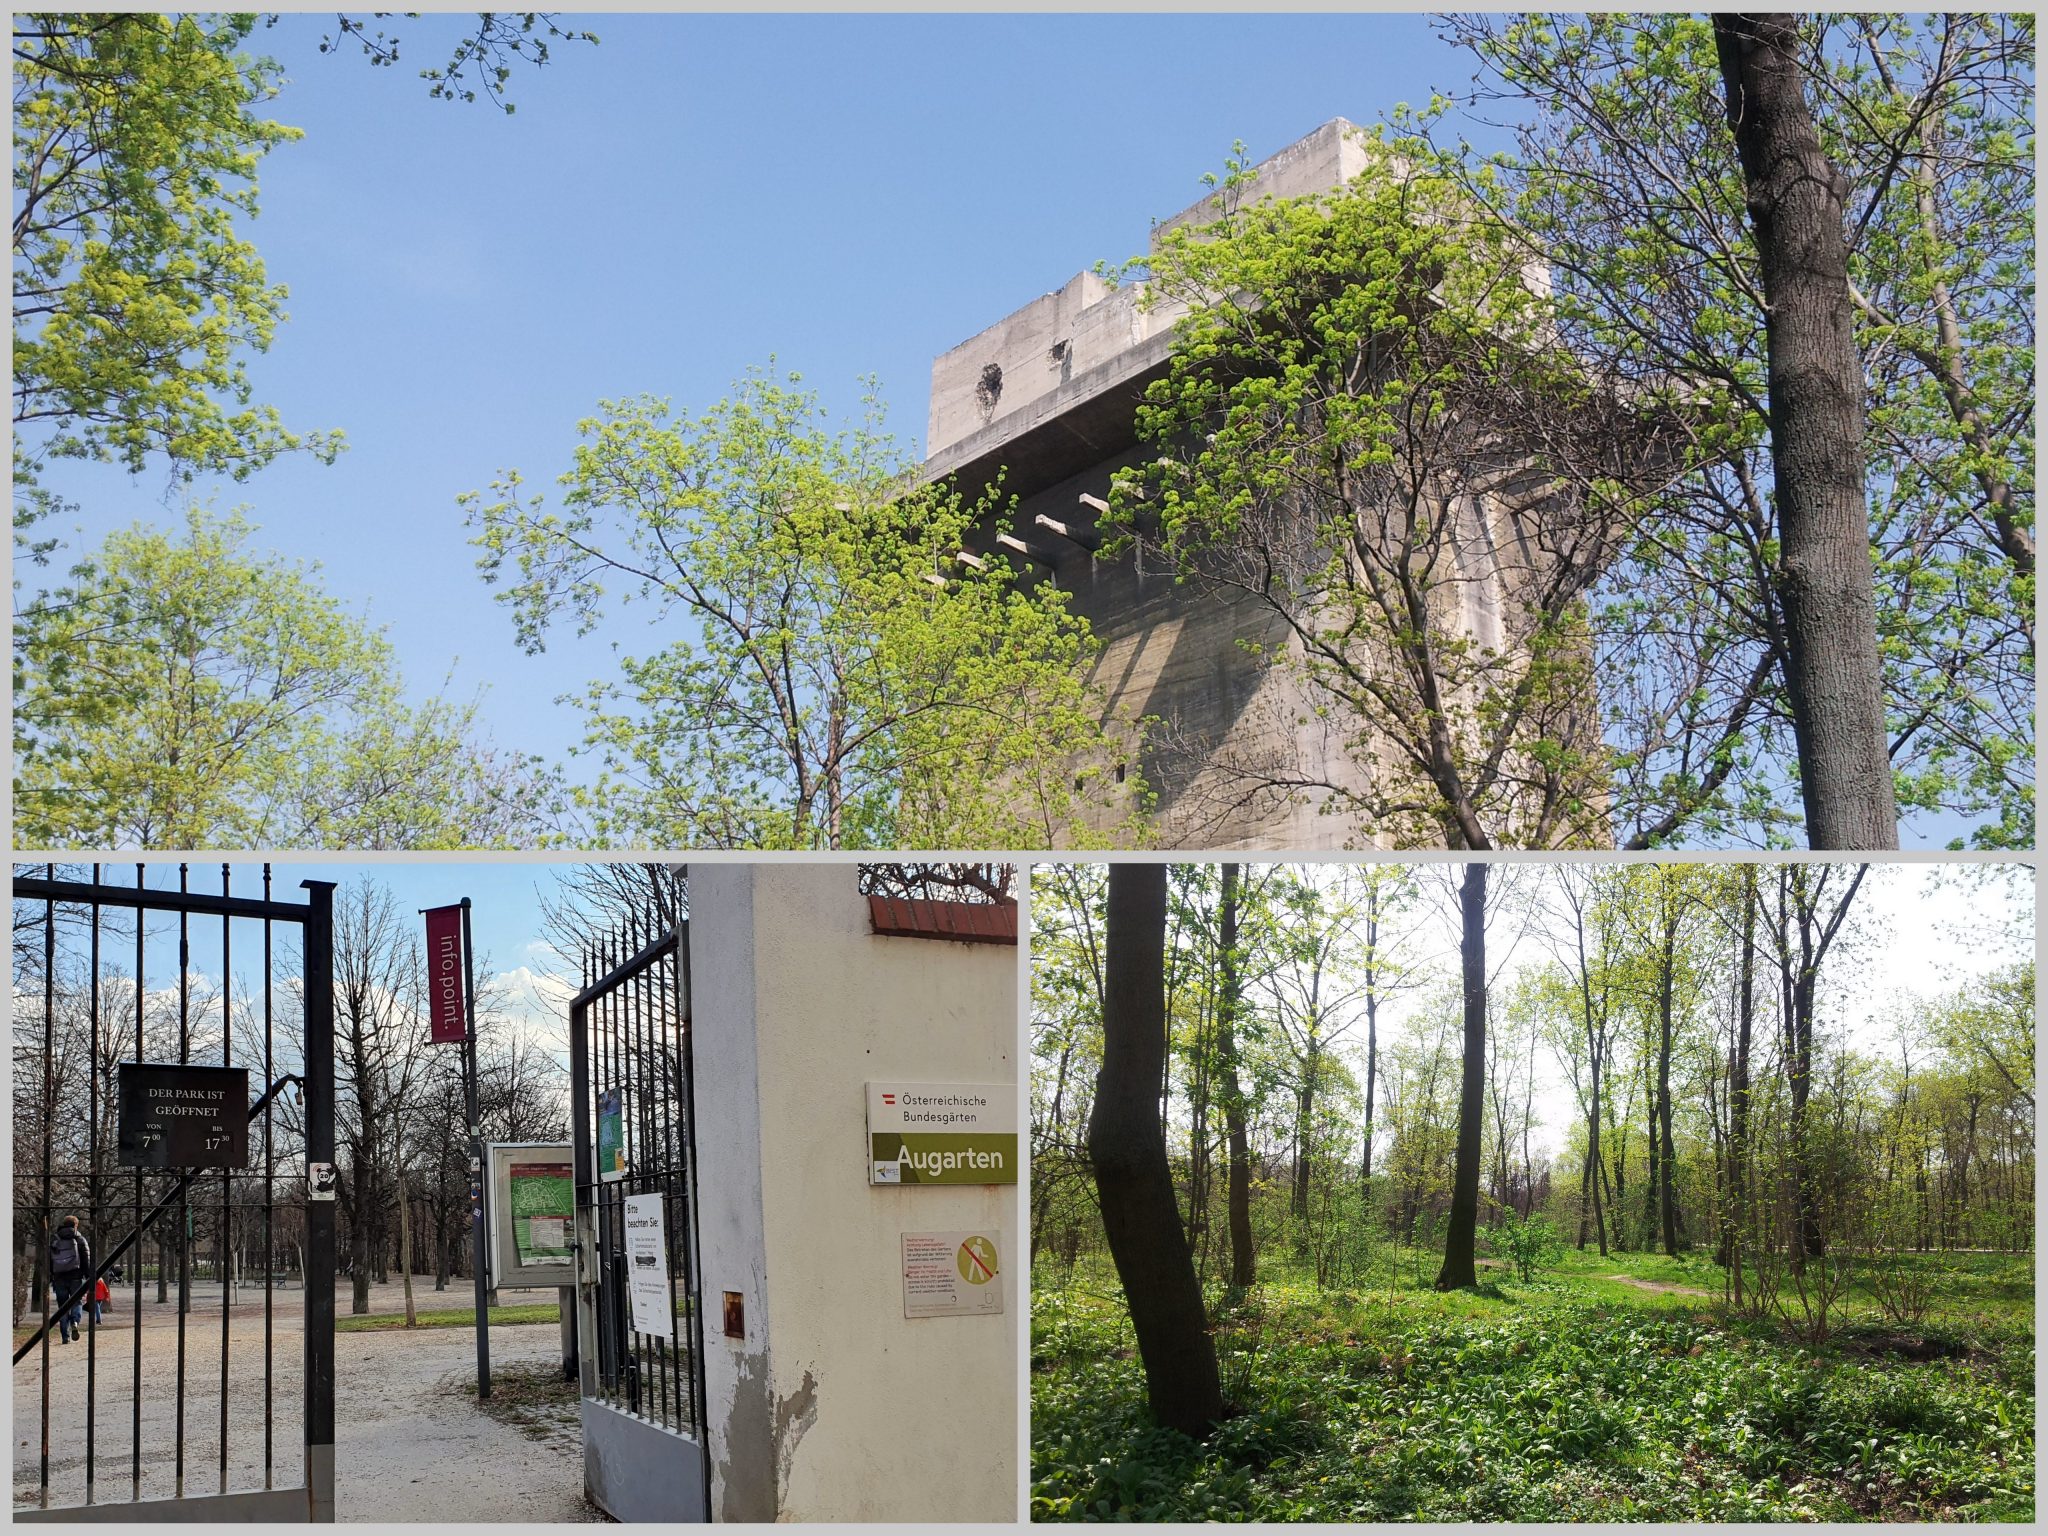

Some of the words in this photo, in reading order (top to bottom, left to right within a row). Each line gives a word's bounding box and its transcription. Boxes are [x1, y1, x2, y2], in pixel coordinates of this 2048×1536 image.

[438, 934, 460, 1030] info.point.
[148, 1088, 173, 1098] DER
[175, 1089, 205, 1099] PARK
[207, 1090, 225, 1100] IST
[902, 1092, 987, 1106] Österreichische
[155, 1104, 219, 1117] GEÖFFNET
[903, 1111, 977, 1125] Bundesgärten
[897, 1144, 1003, 1177] Augarten
[627, 1204, 638, 1214] Bitte
[627, 1217, 648, 1229] beachten
